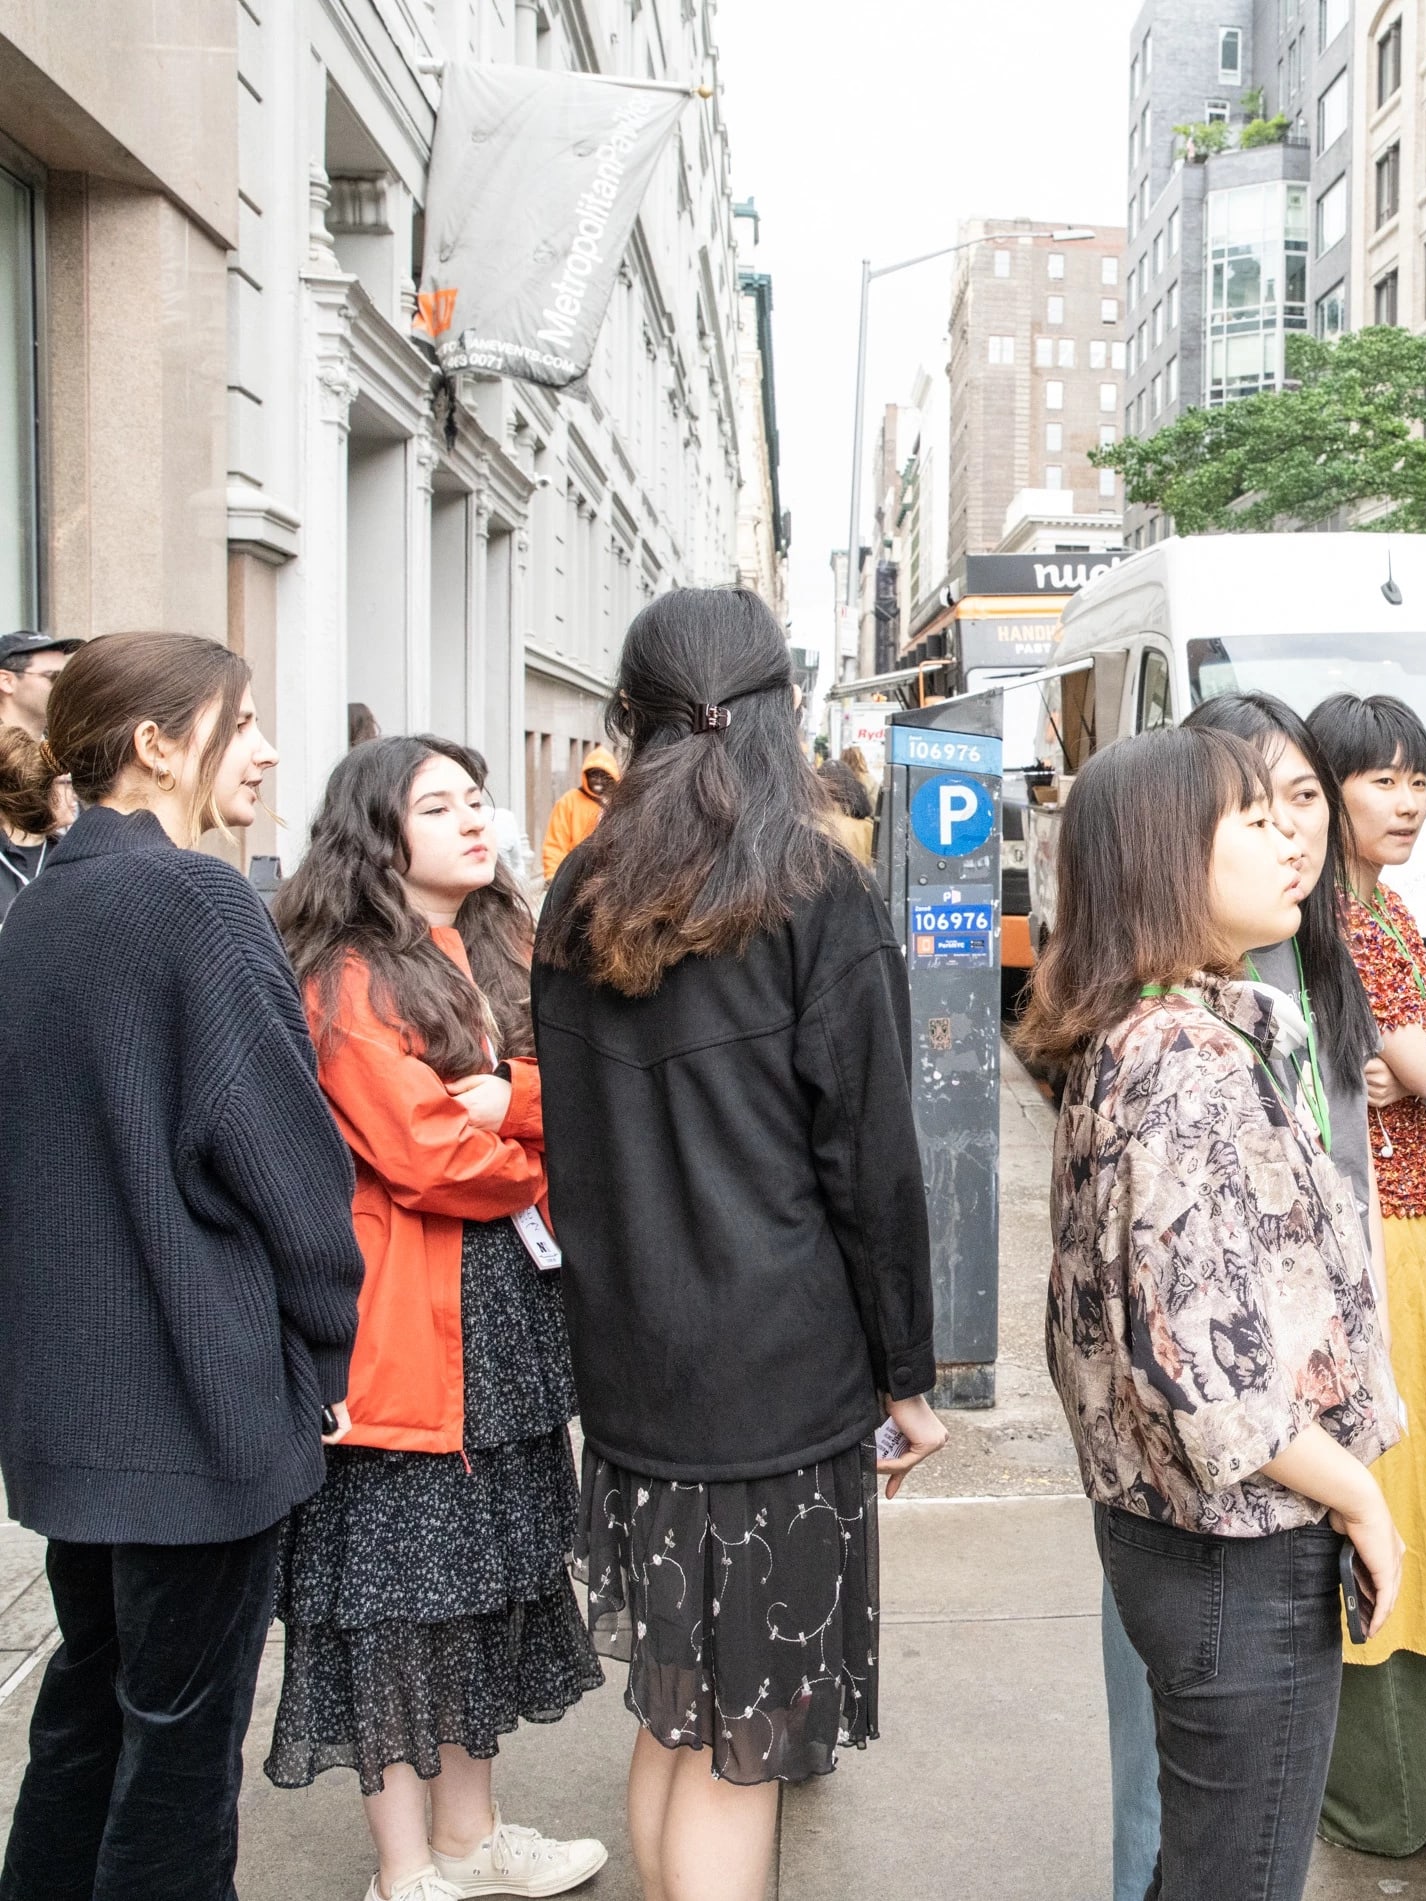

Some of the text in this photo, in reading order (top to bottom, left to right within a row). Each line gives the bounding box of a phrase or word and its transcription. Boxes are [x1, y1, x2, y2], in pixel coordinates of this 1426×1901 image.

[469, 353, 503, 370] 0071
[1033, 557, 1121, 589] nuc
[1015, 643, 1051, 654] PAST
[858, 728, 884, 741] Ryd
[908, 741, 981, 762] 106976
[939, 785, 978, 845] P
[916, 912, 988, 931] 106976
